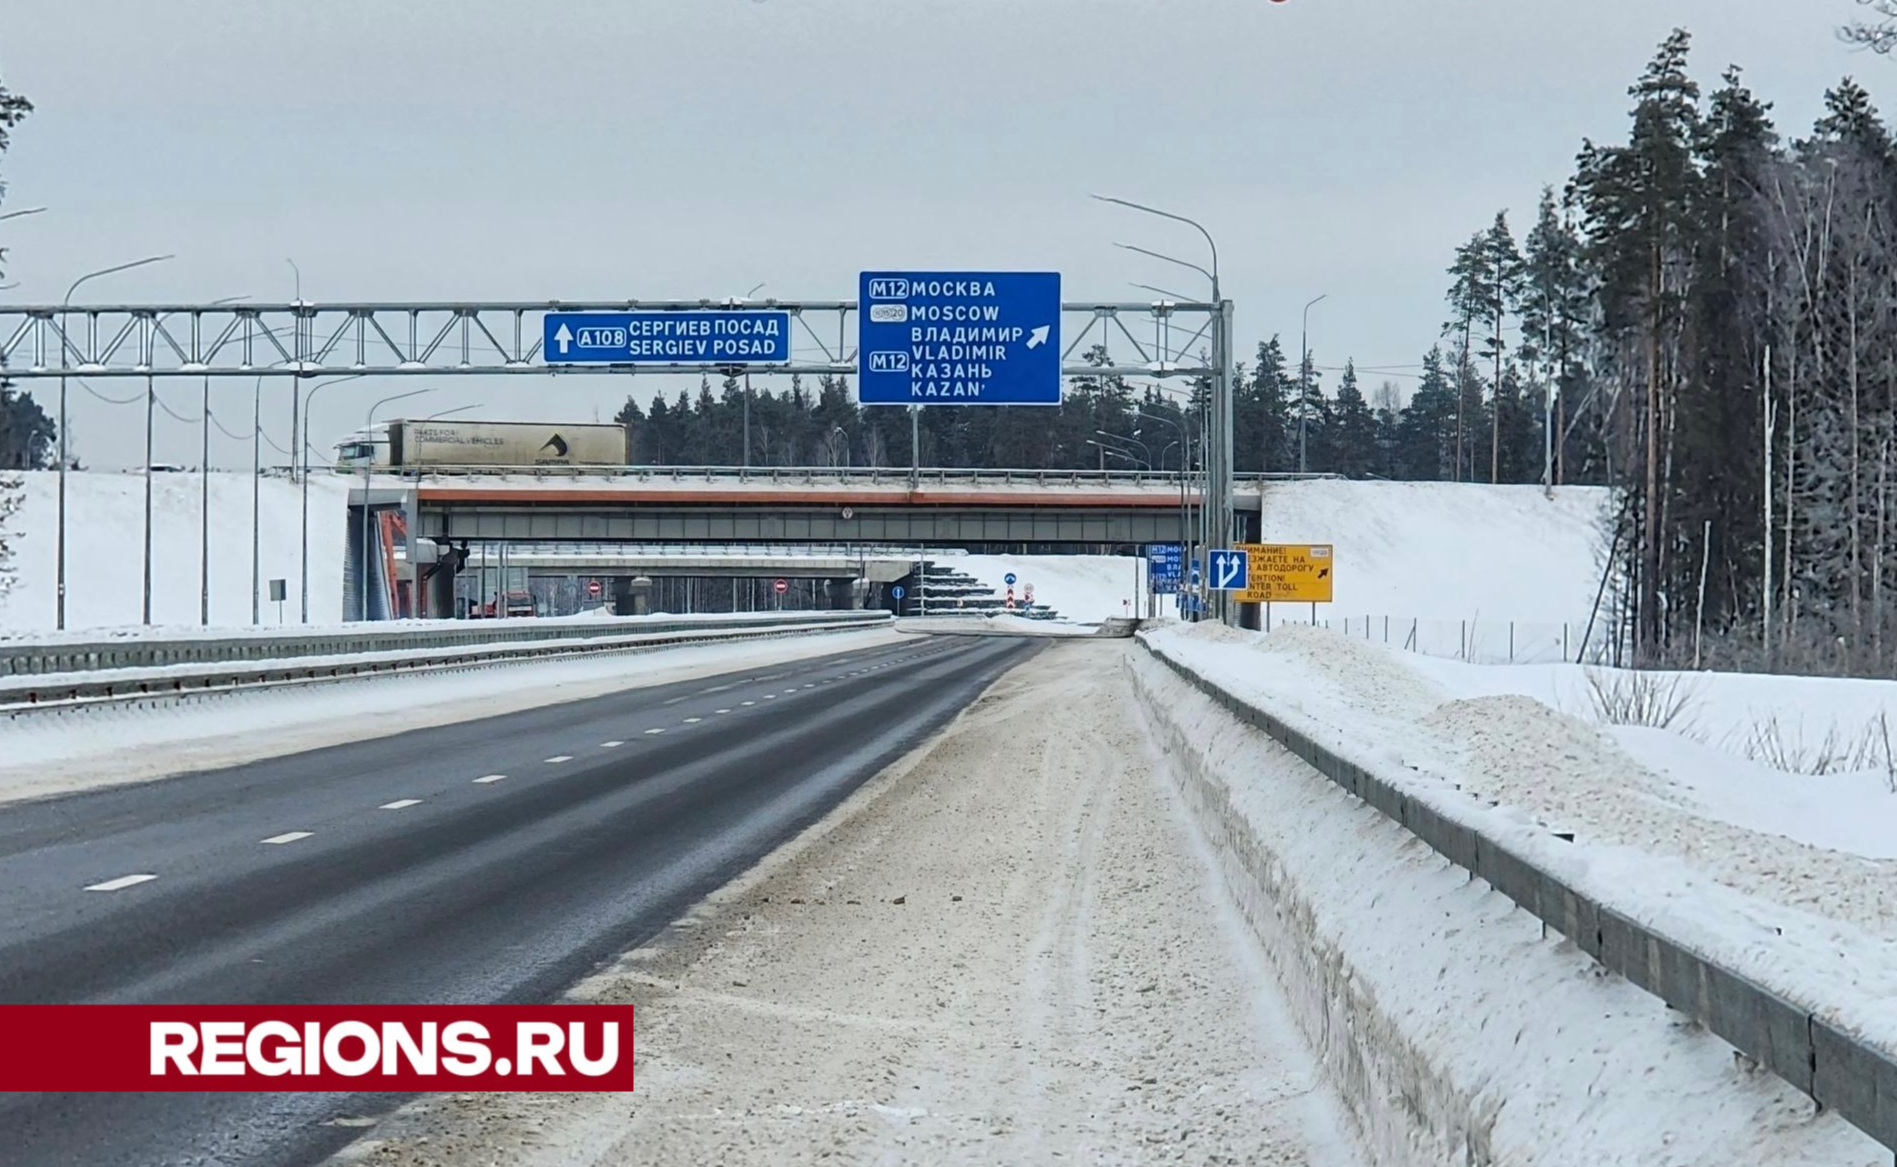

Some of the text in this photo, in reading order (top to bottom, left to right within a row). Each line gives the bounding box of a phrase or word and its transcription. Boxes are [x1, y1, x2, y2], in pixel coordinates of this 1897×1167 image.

[872, 281, 996, 297] М12 МОСКВА
[911, 305, 999, 321] MOSCOW
[629, 319, 779, 337] СЕРГИЕВ ПОСАД
[911, 327, 1023, 344] ВЛАДИМИР
[580, 330, 624, 346] А108
[629, 339, 775, 355] SERGIEV POSAD
[912, 345, 1006, 360] VLADIMIR
[872, 354, 907, 369] М12
[911, 363, 992, 379] КАЗАНЬ
[911, 381, 986, 396] KAZAN'
[467, 437, 505, 445] VEHICLES
[1293, 555, 1305, 563] НА
[1256, 564, 1314, 572] АВТОДОРОГУ
[1249, 582, 1298, 590] NTER TOLL
[1247, 590, 1272, 598] ROAD
